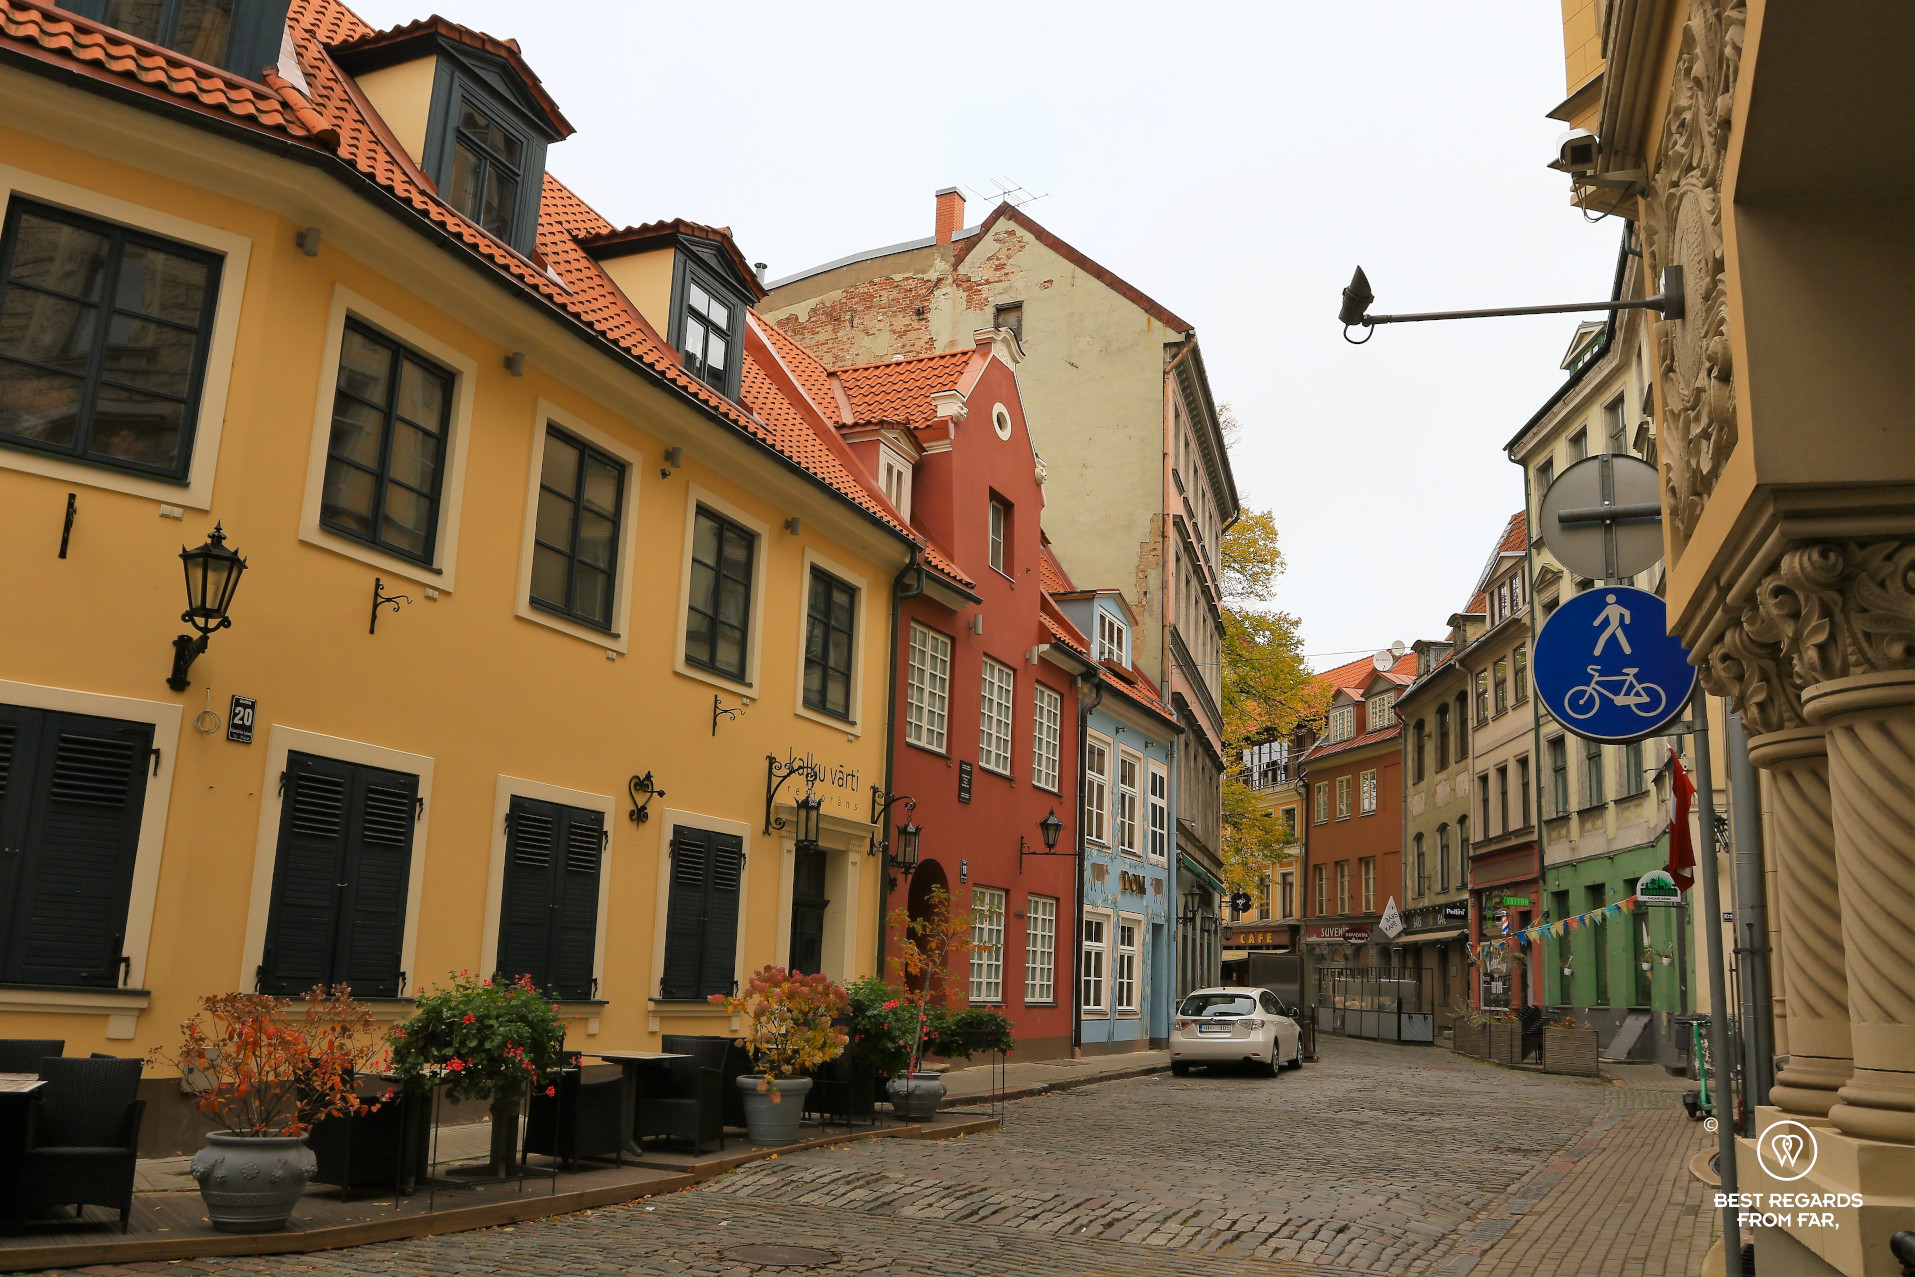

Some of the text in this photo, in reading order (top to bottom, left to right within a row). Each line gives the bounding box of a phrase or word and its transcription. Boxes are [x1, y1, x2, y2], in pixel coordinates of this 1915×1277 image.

[233, 706, 253, 726] 20
[830, 764, 860, 792] vārti
[1446, 908, 1466, 916] Pollini
[1240, 932, 1273, 944] CAFE
[1321, 927, 1345, 937] SUVEN
